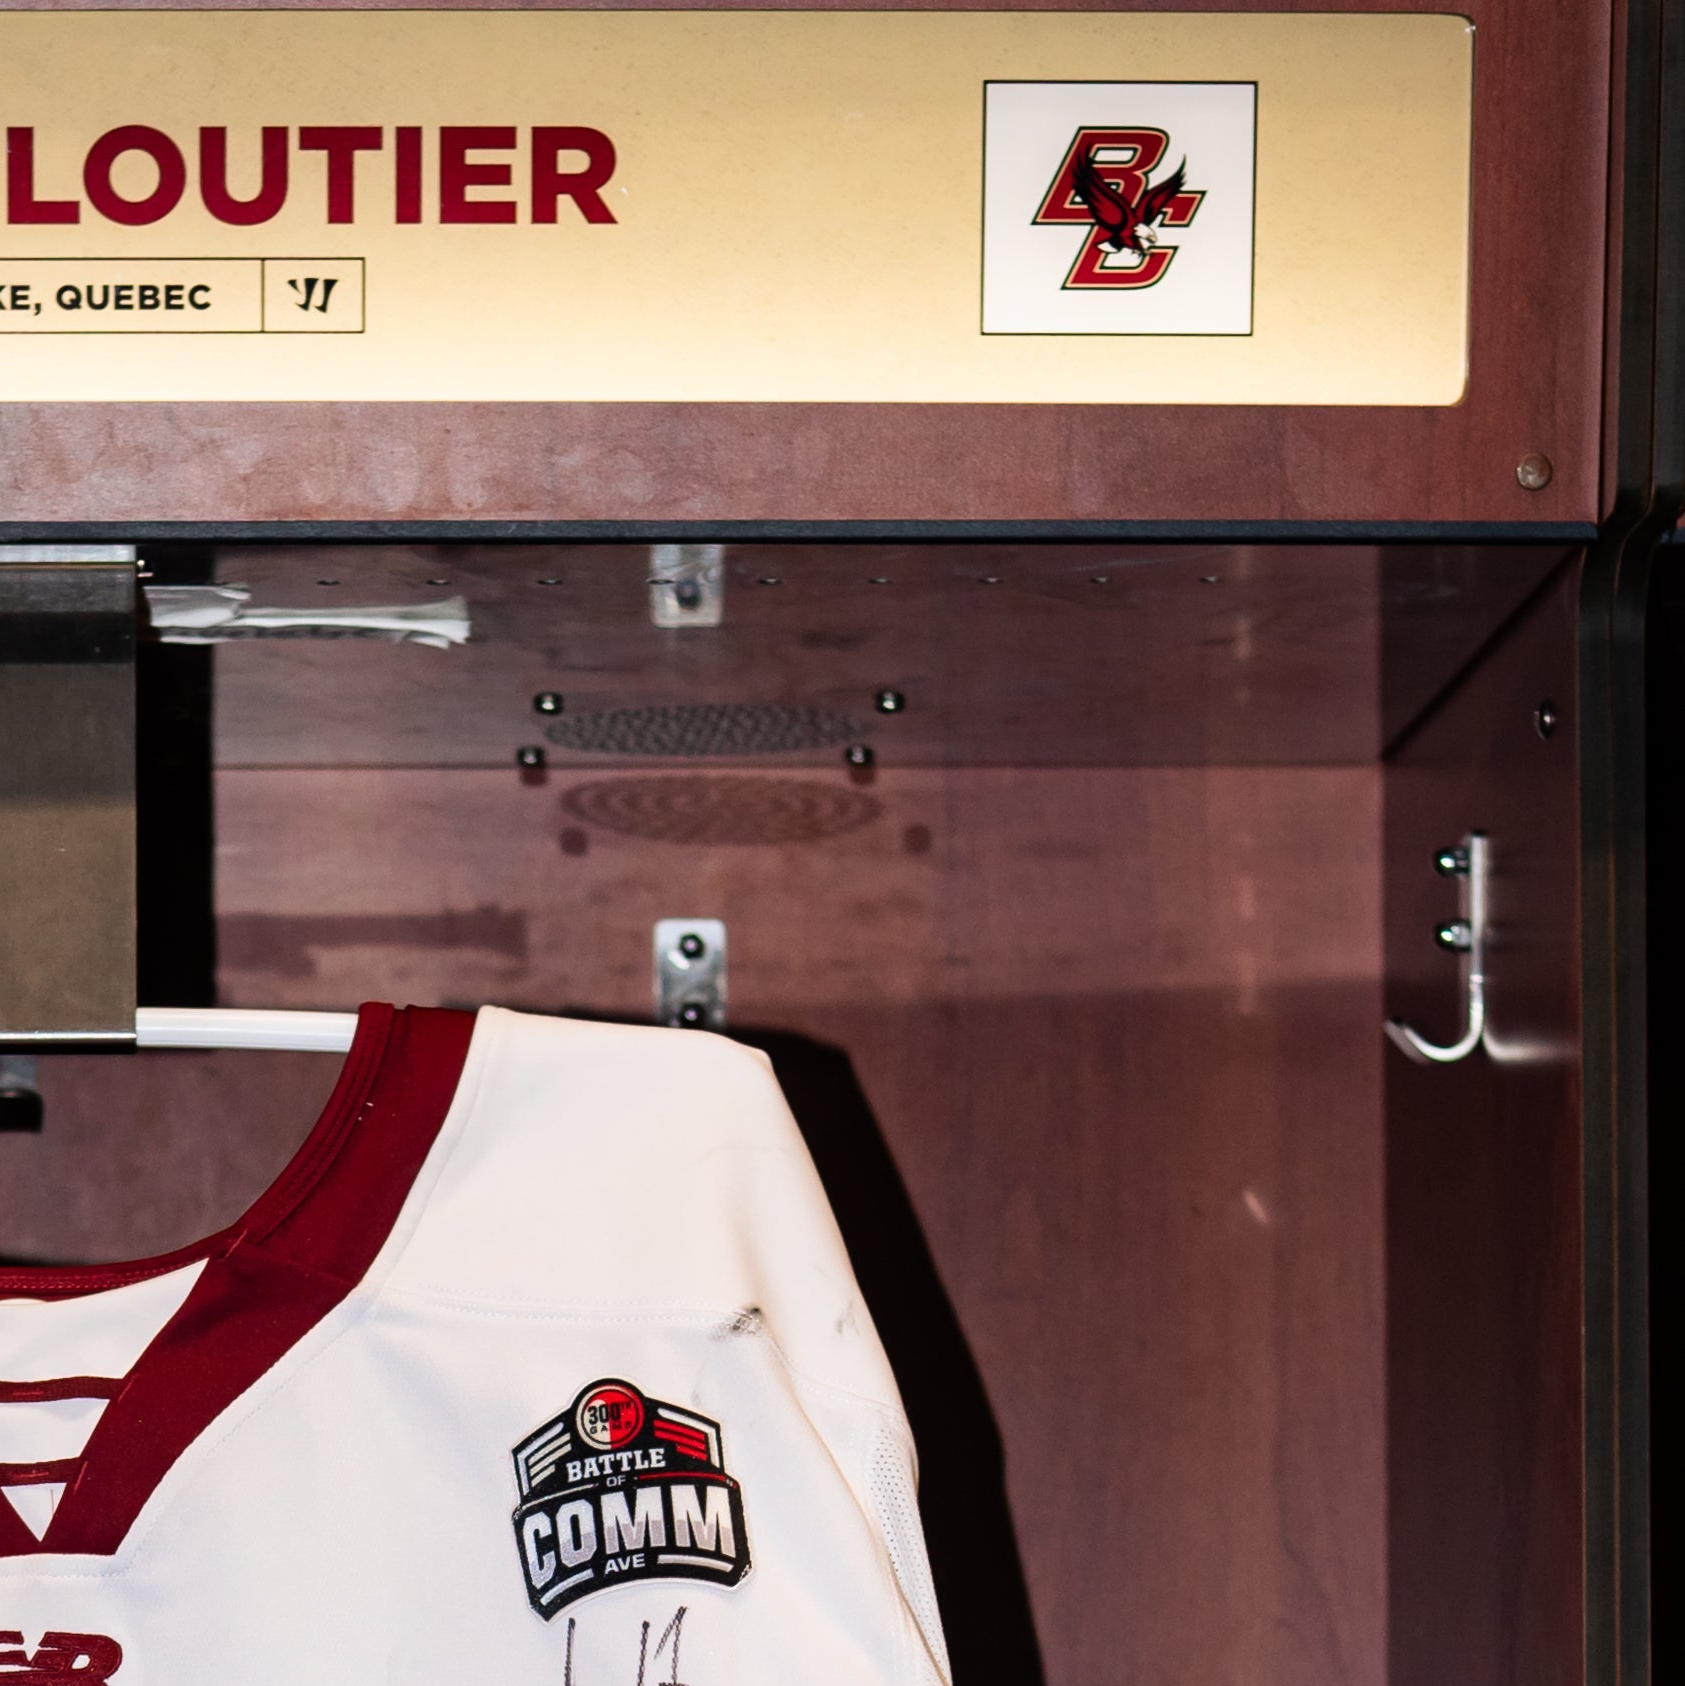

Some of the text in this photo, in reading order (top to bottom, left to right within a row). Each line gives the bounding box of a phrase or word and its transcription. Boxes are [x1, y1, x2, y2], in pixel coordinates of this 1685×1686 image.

[1030, 126, 1208, 291] BC
[56, 284, 212, 312] QUEBEC
[565, 1447, 667, 1483] BATTLE
[606, 1474, 627, 1488] OF
[522, 1484, 737, 1590] COMM
[604, 1553, 646, 1576] AVE
